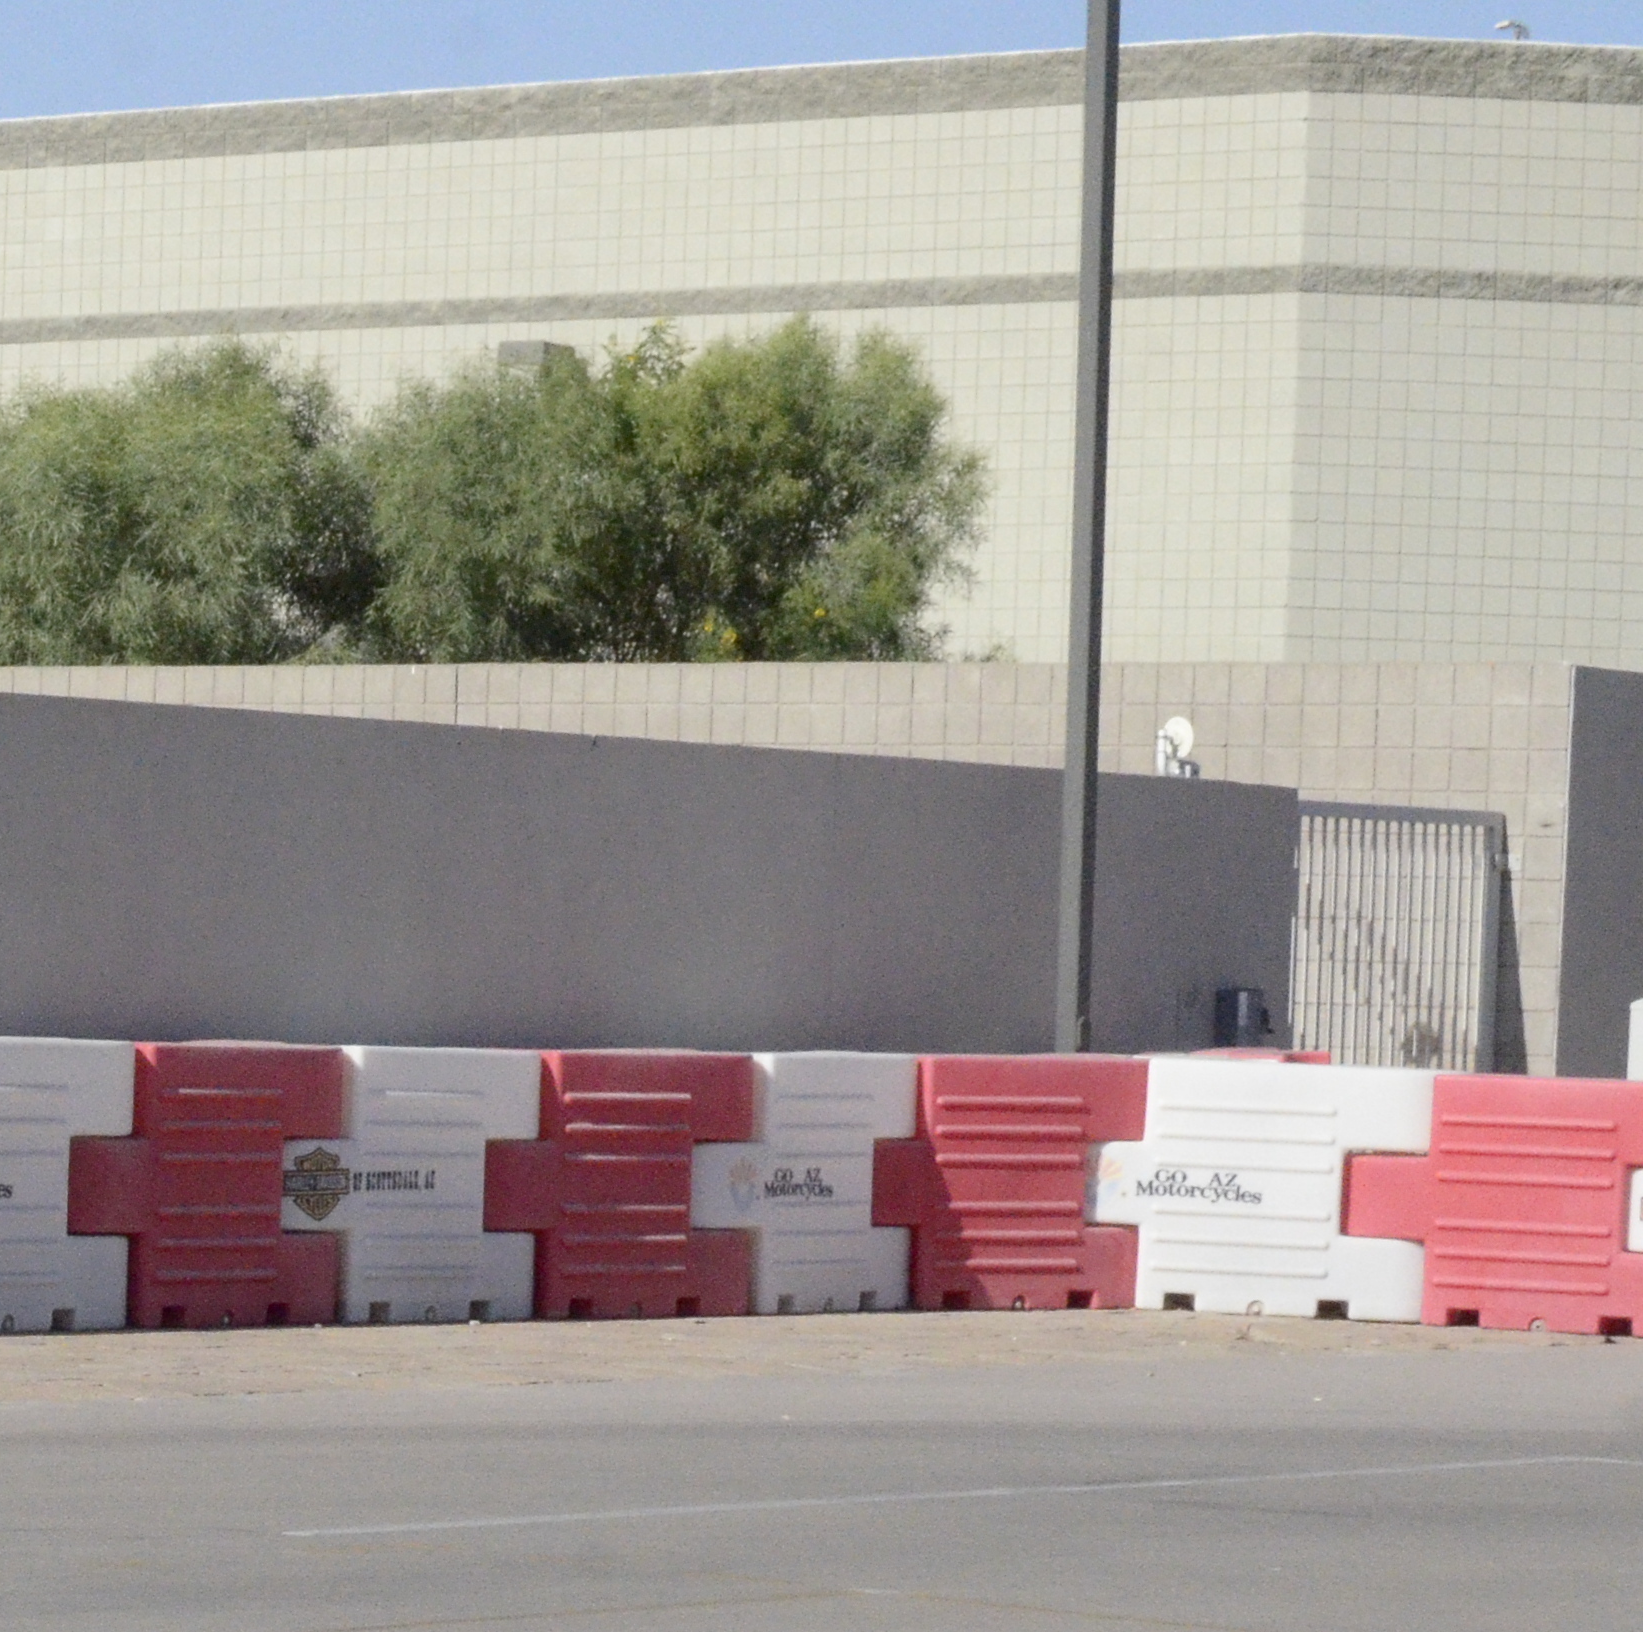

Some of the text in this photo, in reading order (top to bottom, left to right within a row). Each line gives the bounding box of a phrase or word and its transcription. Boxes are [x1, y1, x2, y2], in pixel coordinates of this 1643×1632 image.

[774, 1168, 823, 1183] GO AZ
[1154, 1169, 1238, 1188] GO AZ
[764, 1181, 833, 1201] Motorcycles
[1135, 1180, 1263, 1204] Motorcycles
